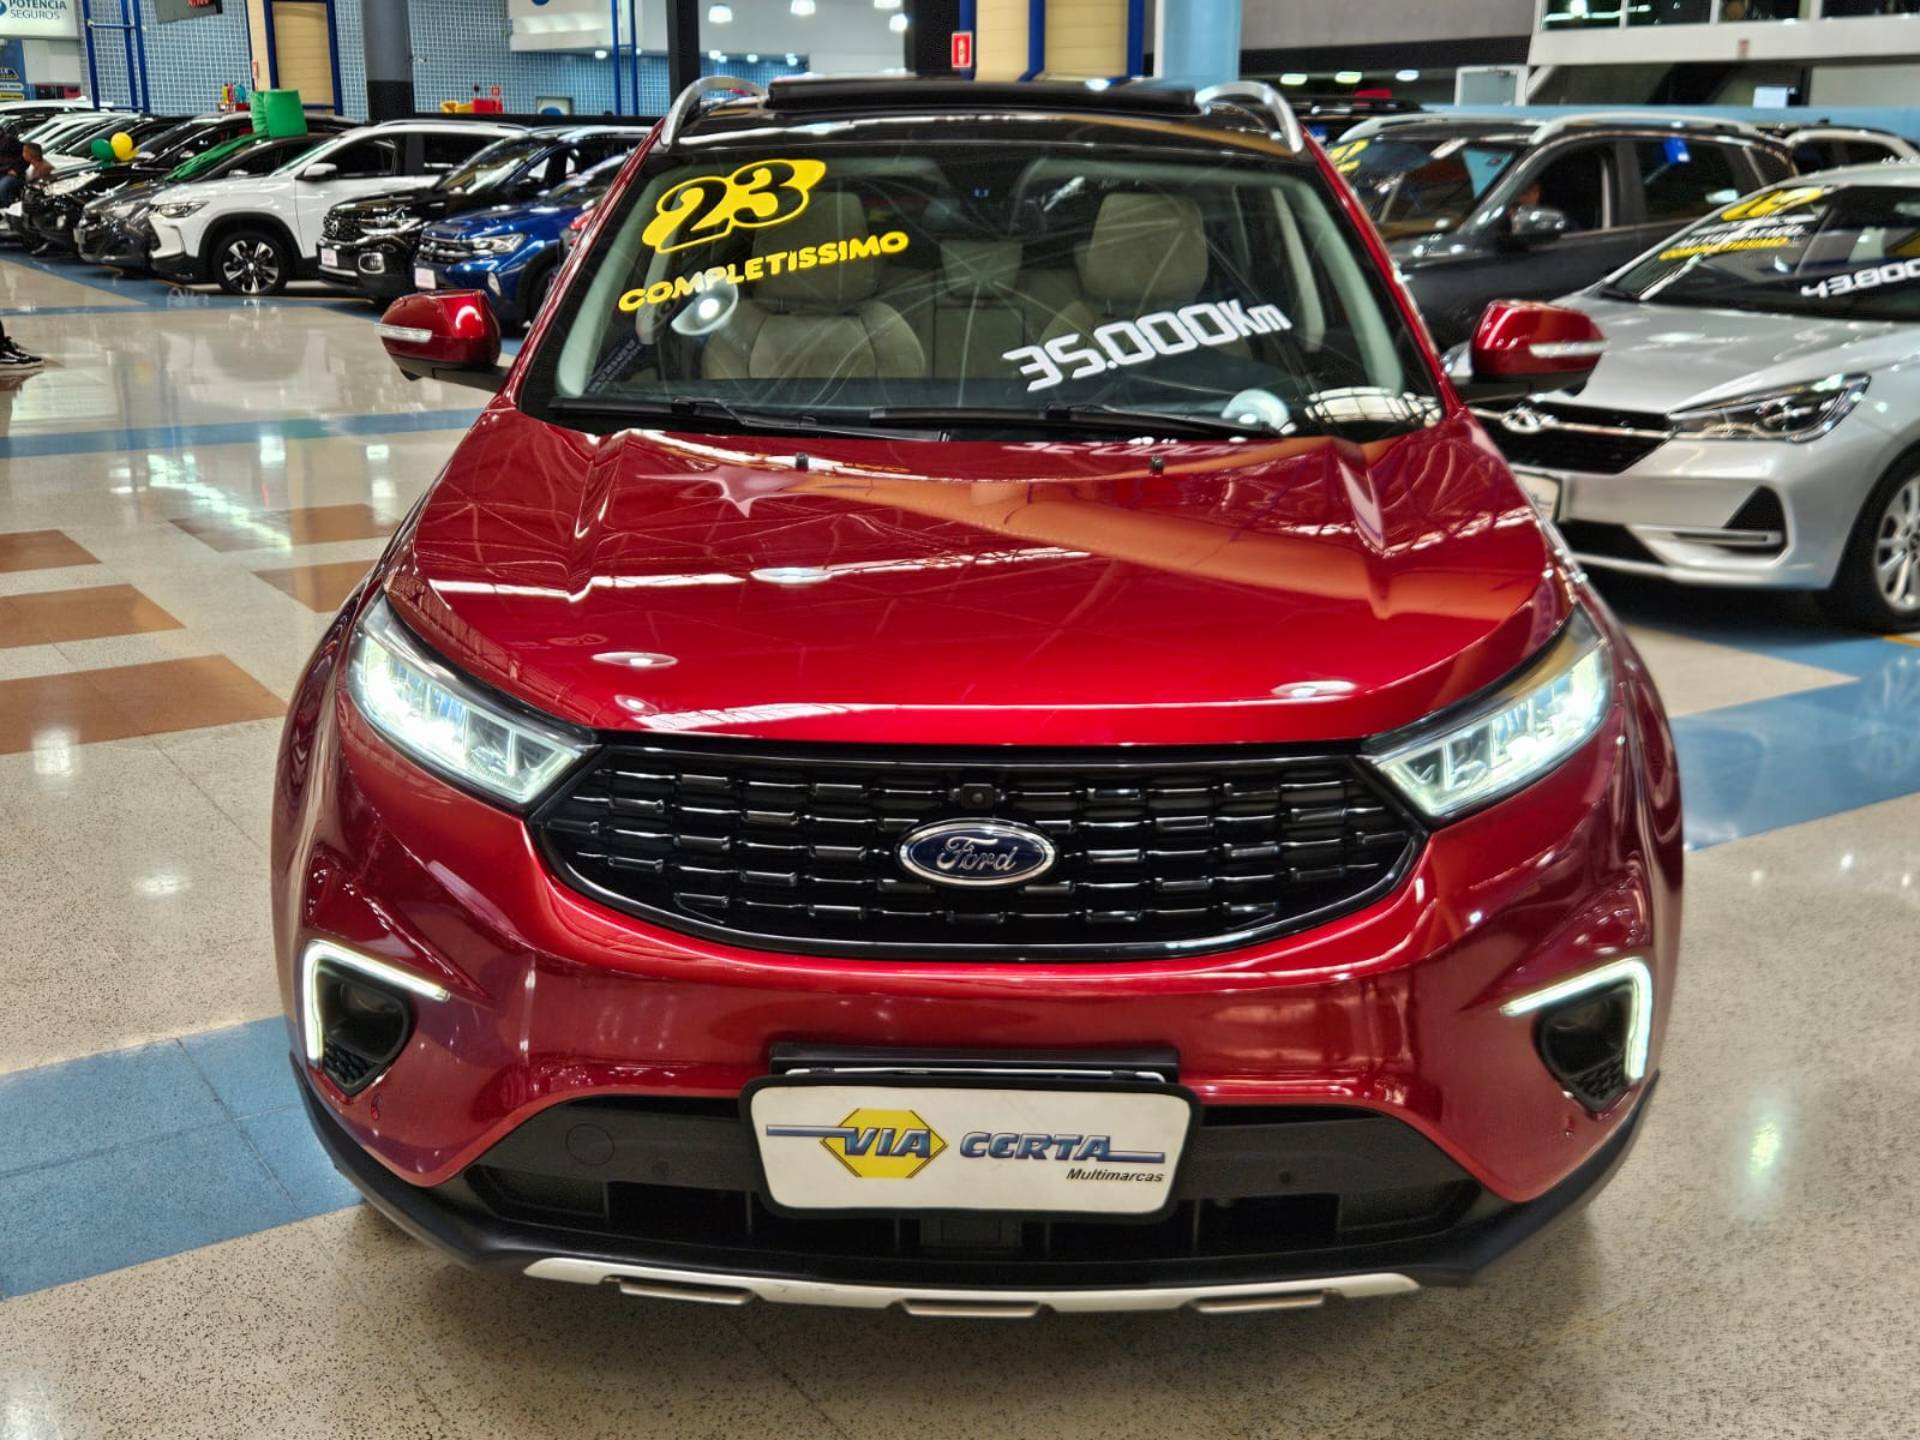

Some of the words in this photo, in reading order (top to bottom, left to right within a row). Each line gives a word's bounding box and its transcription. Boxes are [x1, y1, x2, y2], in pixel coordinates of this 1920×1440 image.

[10, 9, 60, 19] SEGUROS
[643, 158, 826, 254] 23
[618, 231, 909, 312] COMPLETISSIMO
[936, 836, 1019, 871] Ford
[839, 1126, 931, 1158] VIA
[959, 1131, 1114, 1163] CERTA
[1066, 1167, 1163, 1183] Multimarcas
